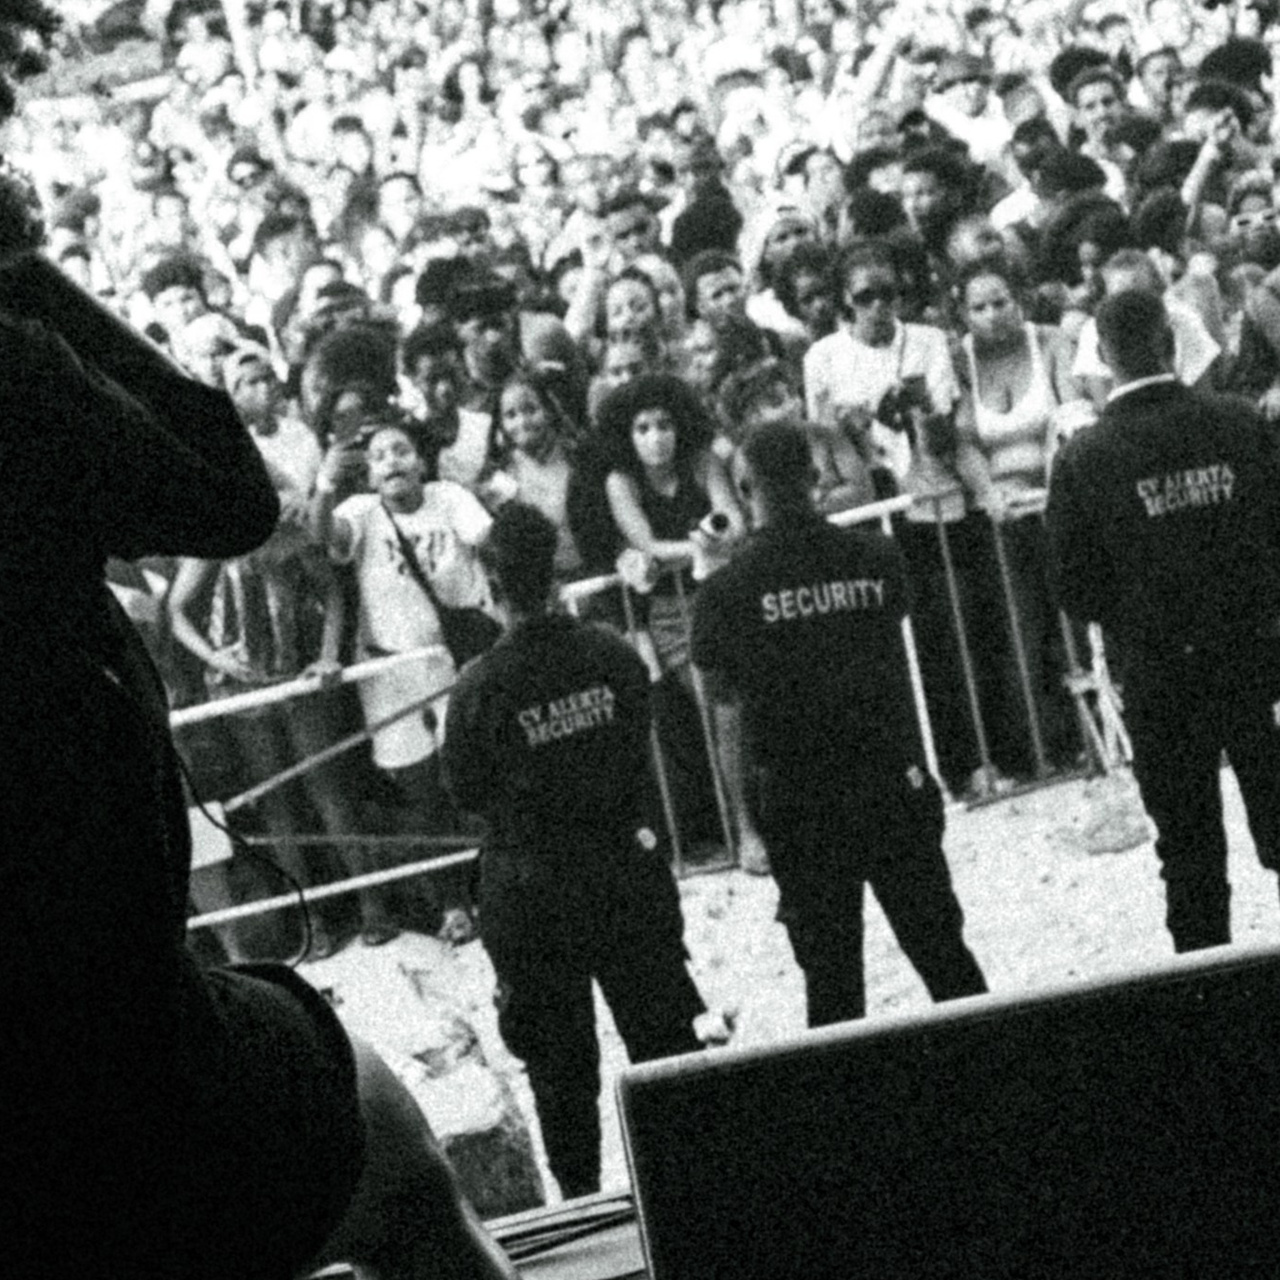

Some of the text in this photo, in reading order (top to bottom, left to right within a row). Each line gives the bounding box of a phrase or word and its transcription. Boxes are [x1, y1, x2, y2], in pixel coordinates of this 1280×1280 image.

[1143, 481, 1234, 516] SECURITY
[762, 579, 884, 622] SECURITY
[525, 705, 616, 746] SECURITY
